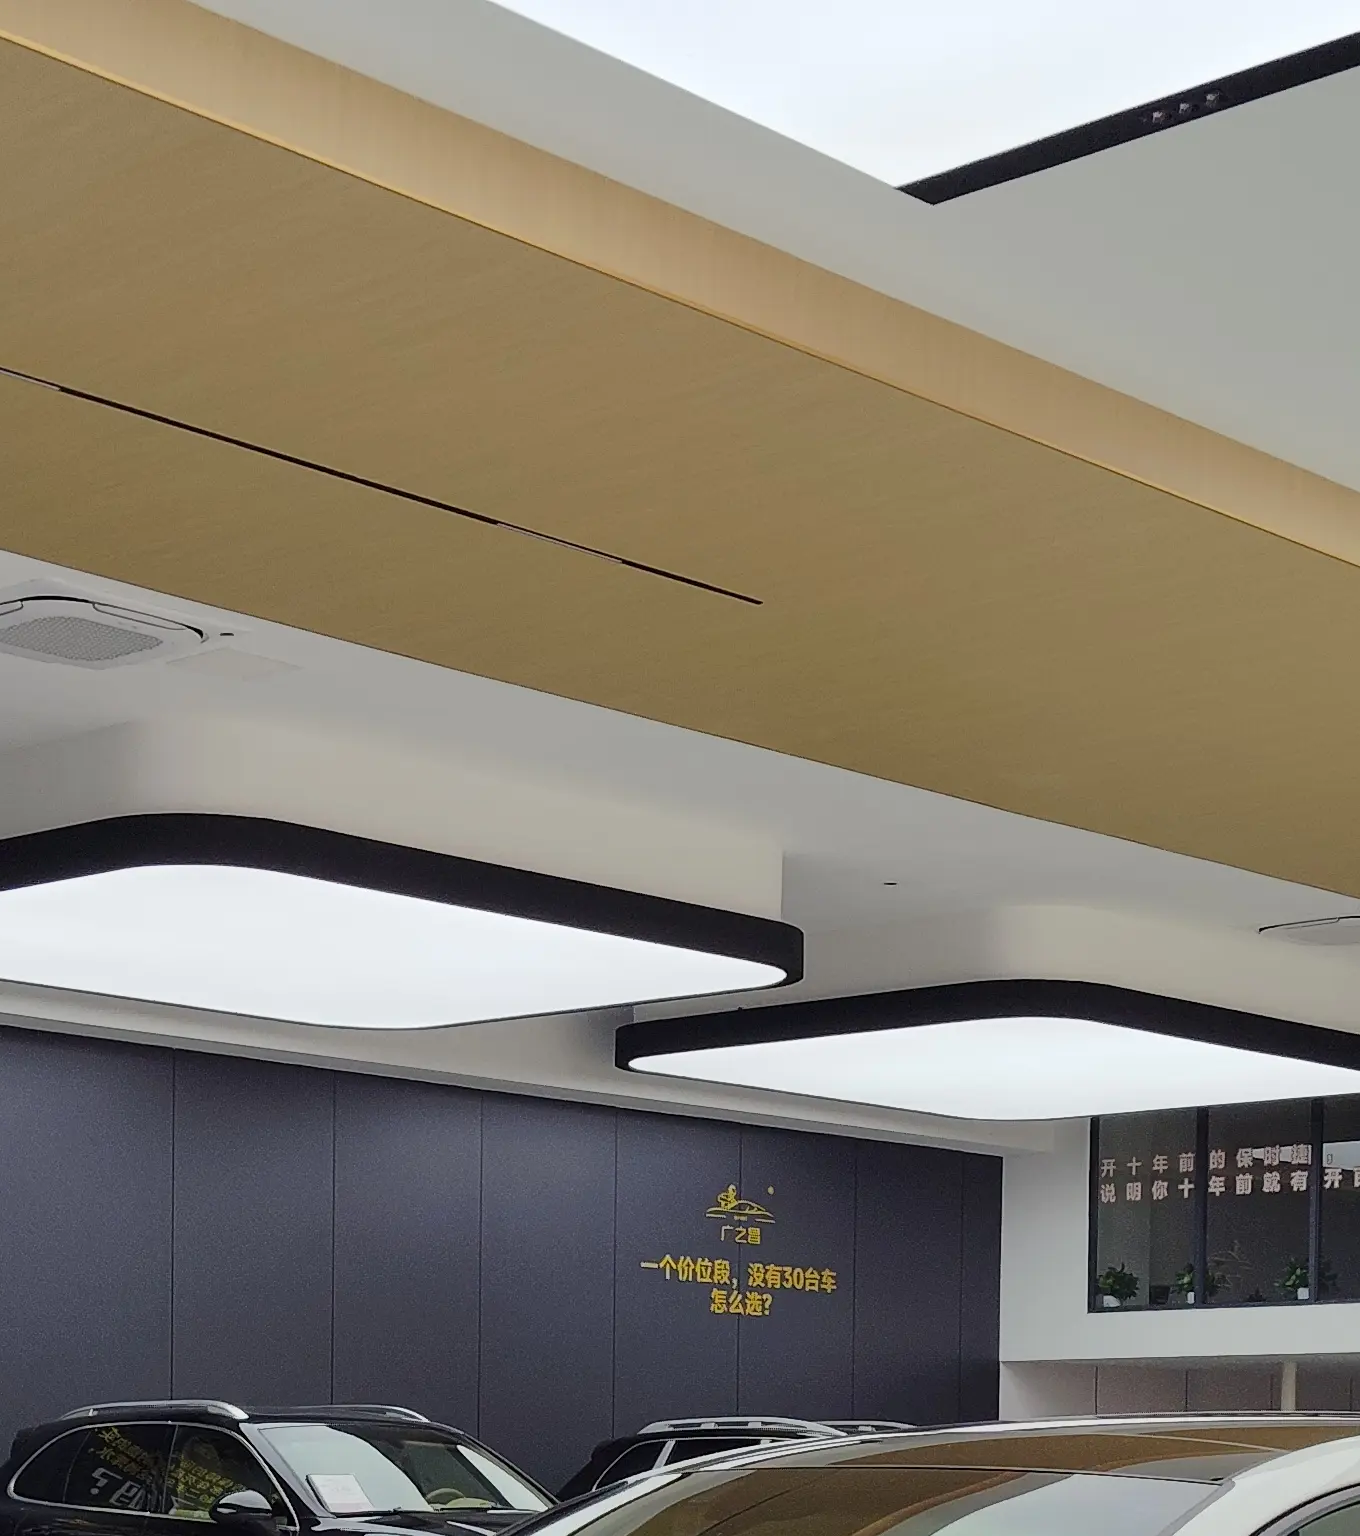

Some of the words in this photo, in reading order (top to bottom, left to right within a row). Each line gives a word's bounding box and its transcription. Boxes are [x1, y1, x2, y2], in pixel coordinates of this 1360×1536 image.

[640, 1253, 838, 1293] 一个价位段，没有30台车
[710, 1287, 773, 1316] 怎么选？
